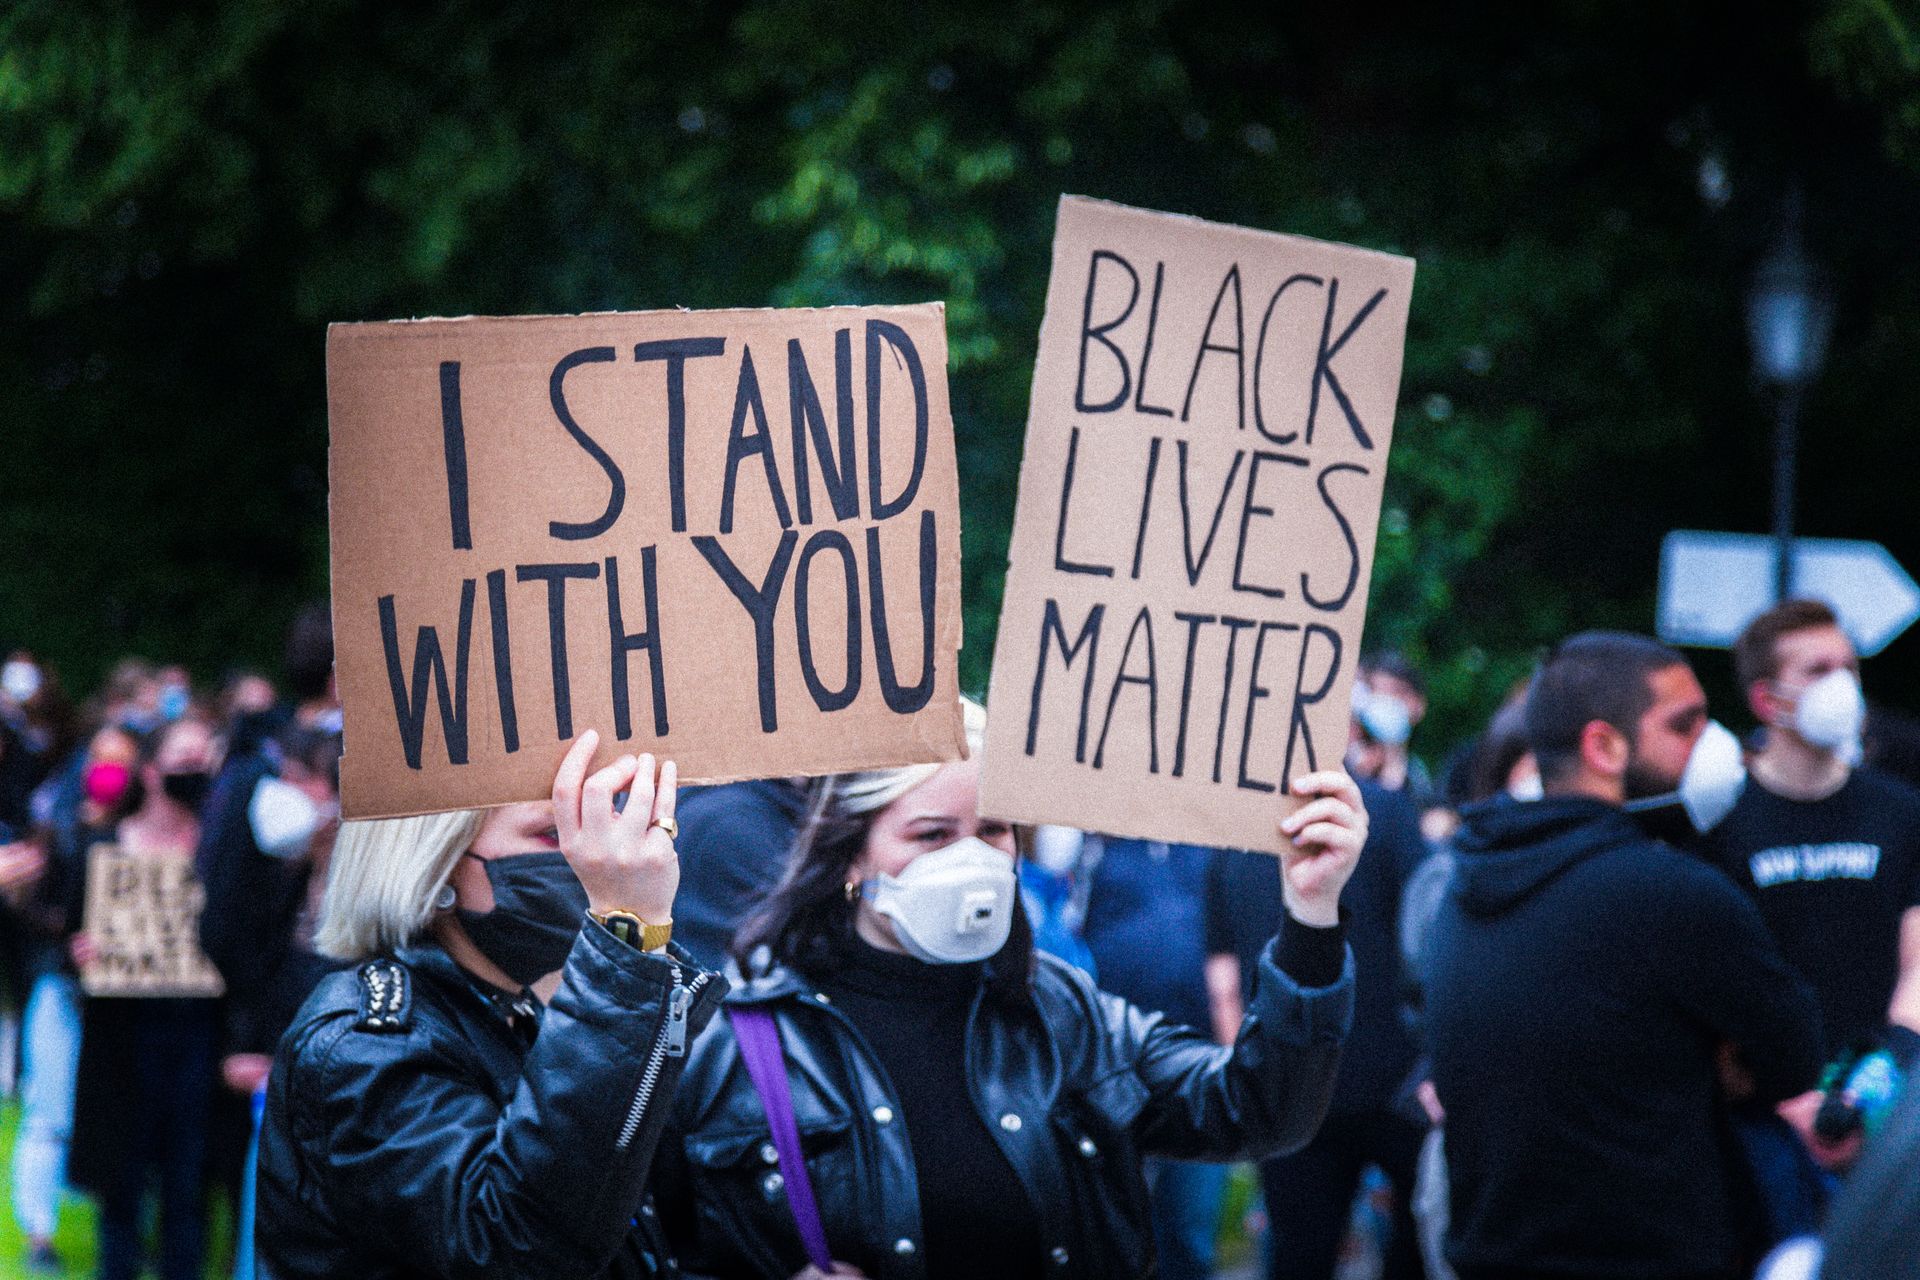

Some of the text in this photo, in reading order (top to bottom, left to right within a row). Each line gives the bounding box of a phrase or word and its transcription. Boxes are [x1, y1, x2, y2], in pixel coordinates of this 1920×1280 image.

[439, 319, 929, 550] I STAND
[1076, 250, 1388, 450] BLACK
[1055, 427, 1369, 612] LIVES
[377, 510, 937, 769] WITH YOU
[1025, 599, 1343, 795] MATTER
